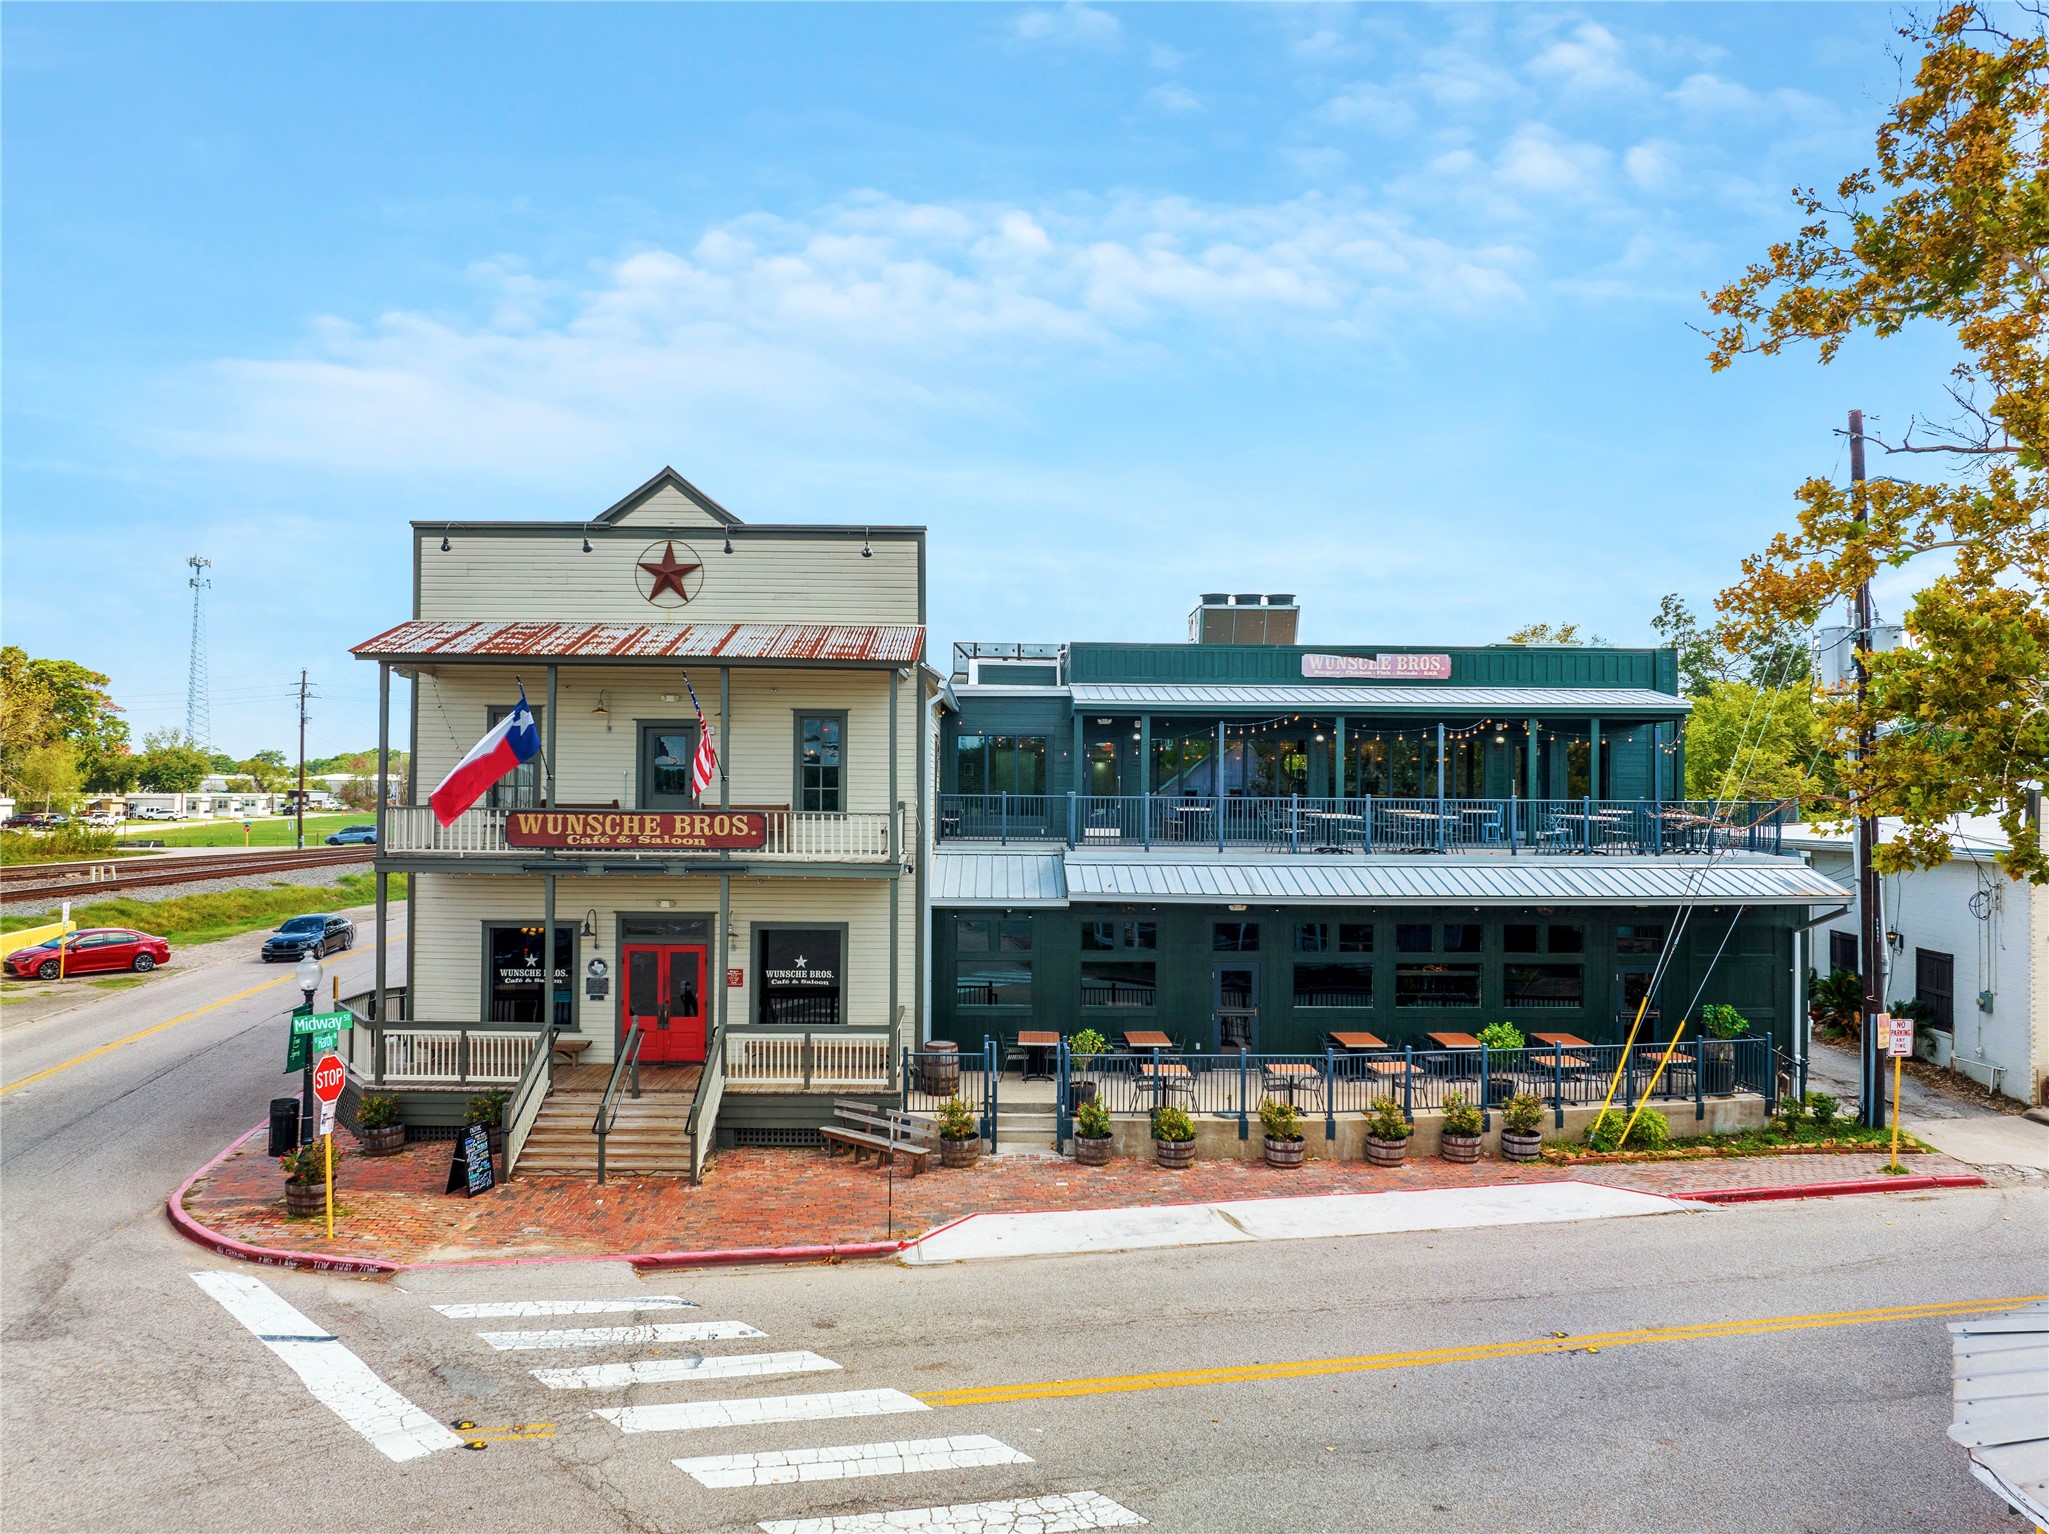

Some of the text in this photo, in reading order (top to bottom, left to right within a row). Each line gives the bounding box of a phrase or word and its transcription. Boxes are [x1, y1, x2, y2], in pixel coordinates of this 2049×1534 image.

[1309, 656, 1445, 671] WUNSCHE BROS.
[517, 814, 757, 836] WUNSCHE BROS.
[567, 836, 706, 846] Café & Saloon
[499, 969, 542, 977] WUNSCHE
[766, 970, 835, 978] WUNSCHE BROS.
[295, 1016, 343, 1032] Midway
[1896, 1021, 1906, 1029] NO
[316, 1068, 343, 1089] STOP
